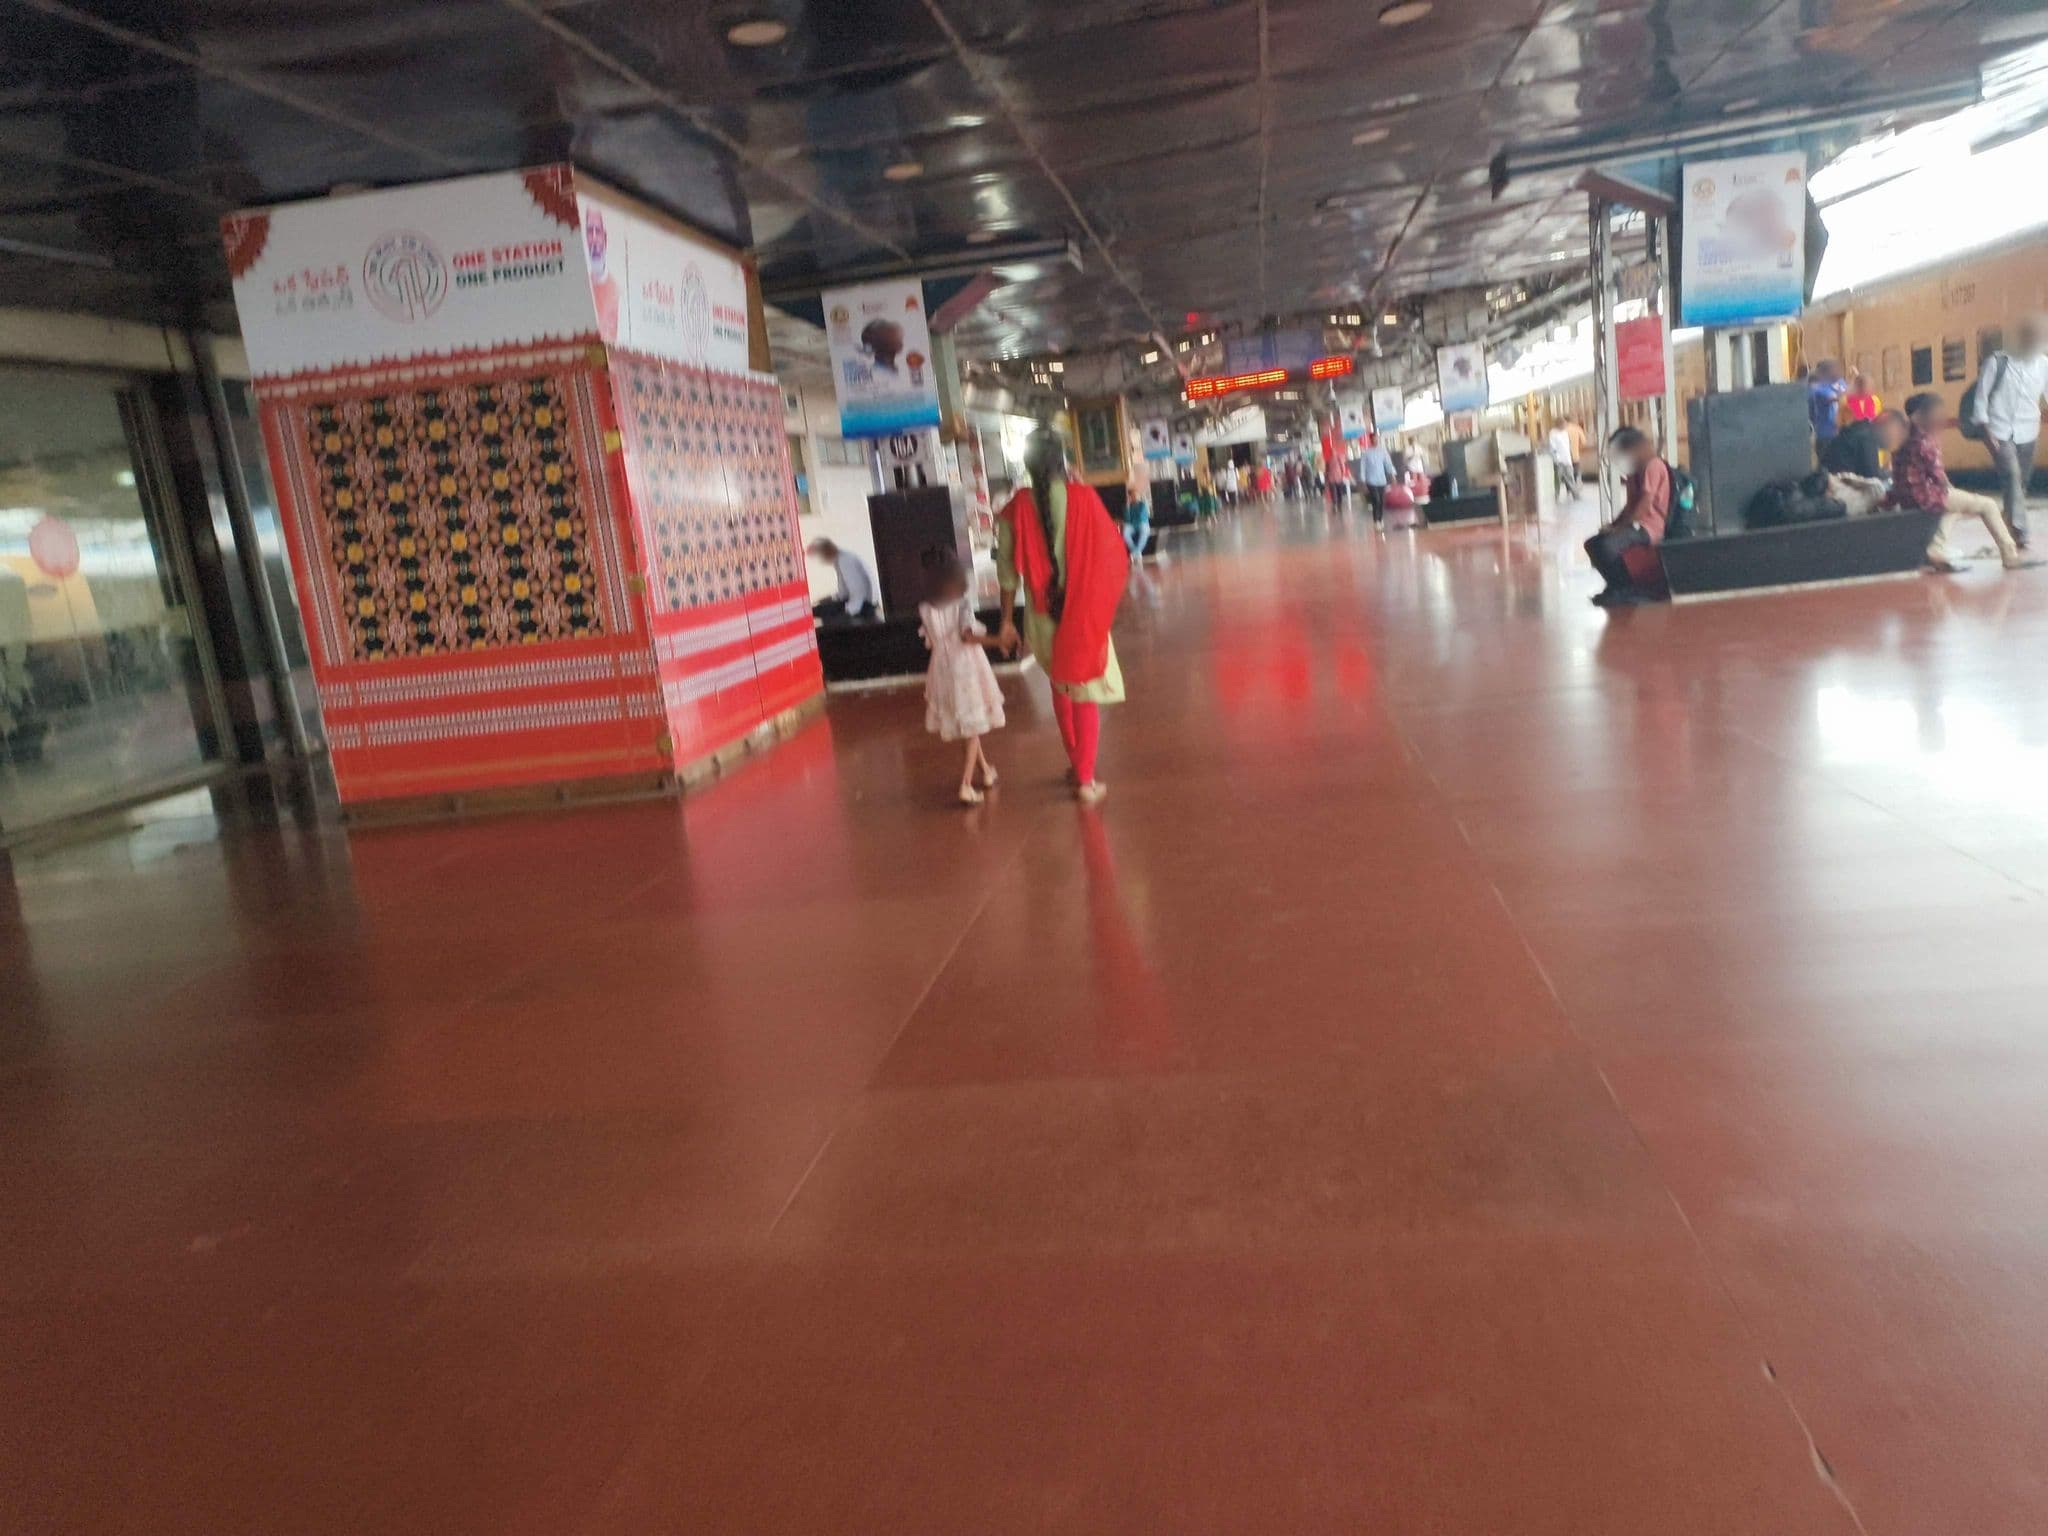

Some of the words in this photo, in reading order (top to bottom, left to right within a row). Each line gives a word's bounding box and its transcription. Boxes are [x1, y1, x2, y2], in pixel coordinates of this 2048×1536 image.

[453, 250, 486, 269] ONE
[492, 240, 563, 262] STATION
[456, 271, 487, 288] ONE
[493, 260, 563, 281] PRODUCT
